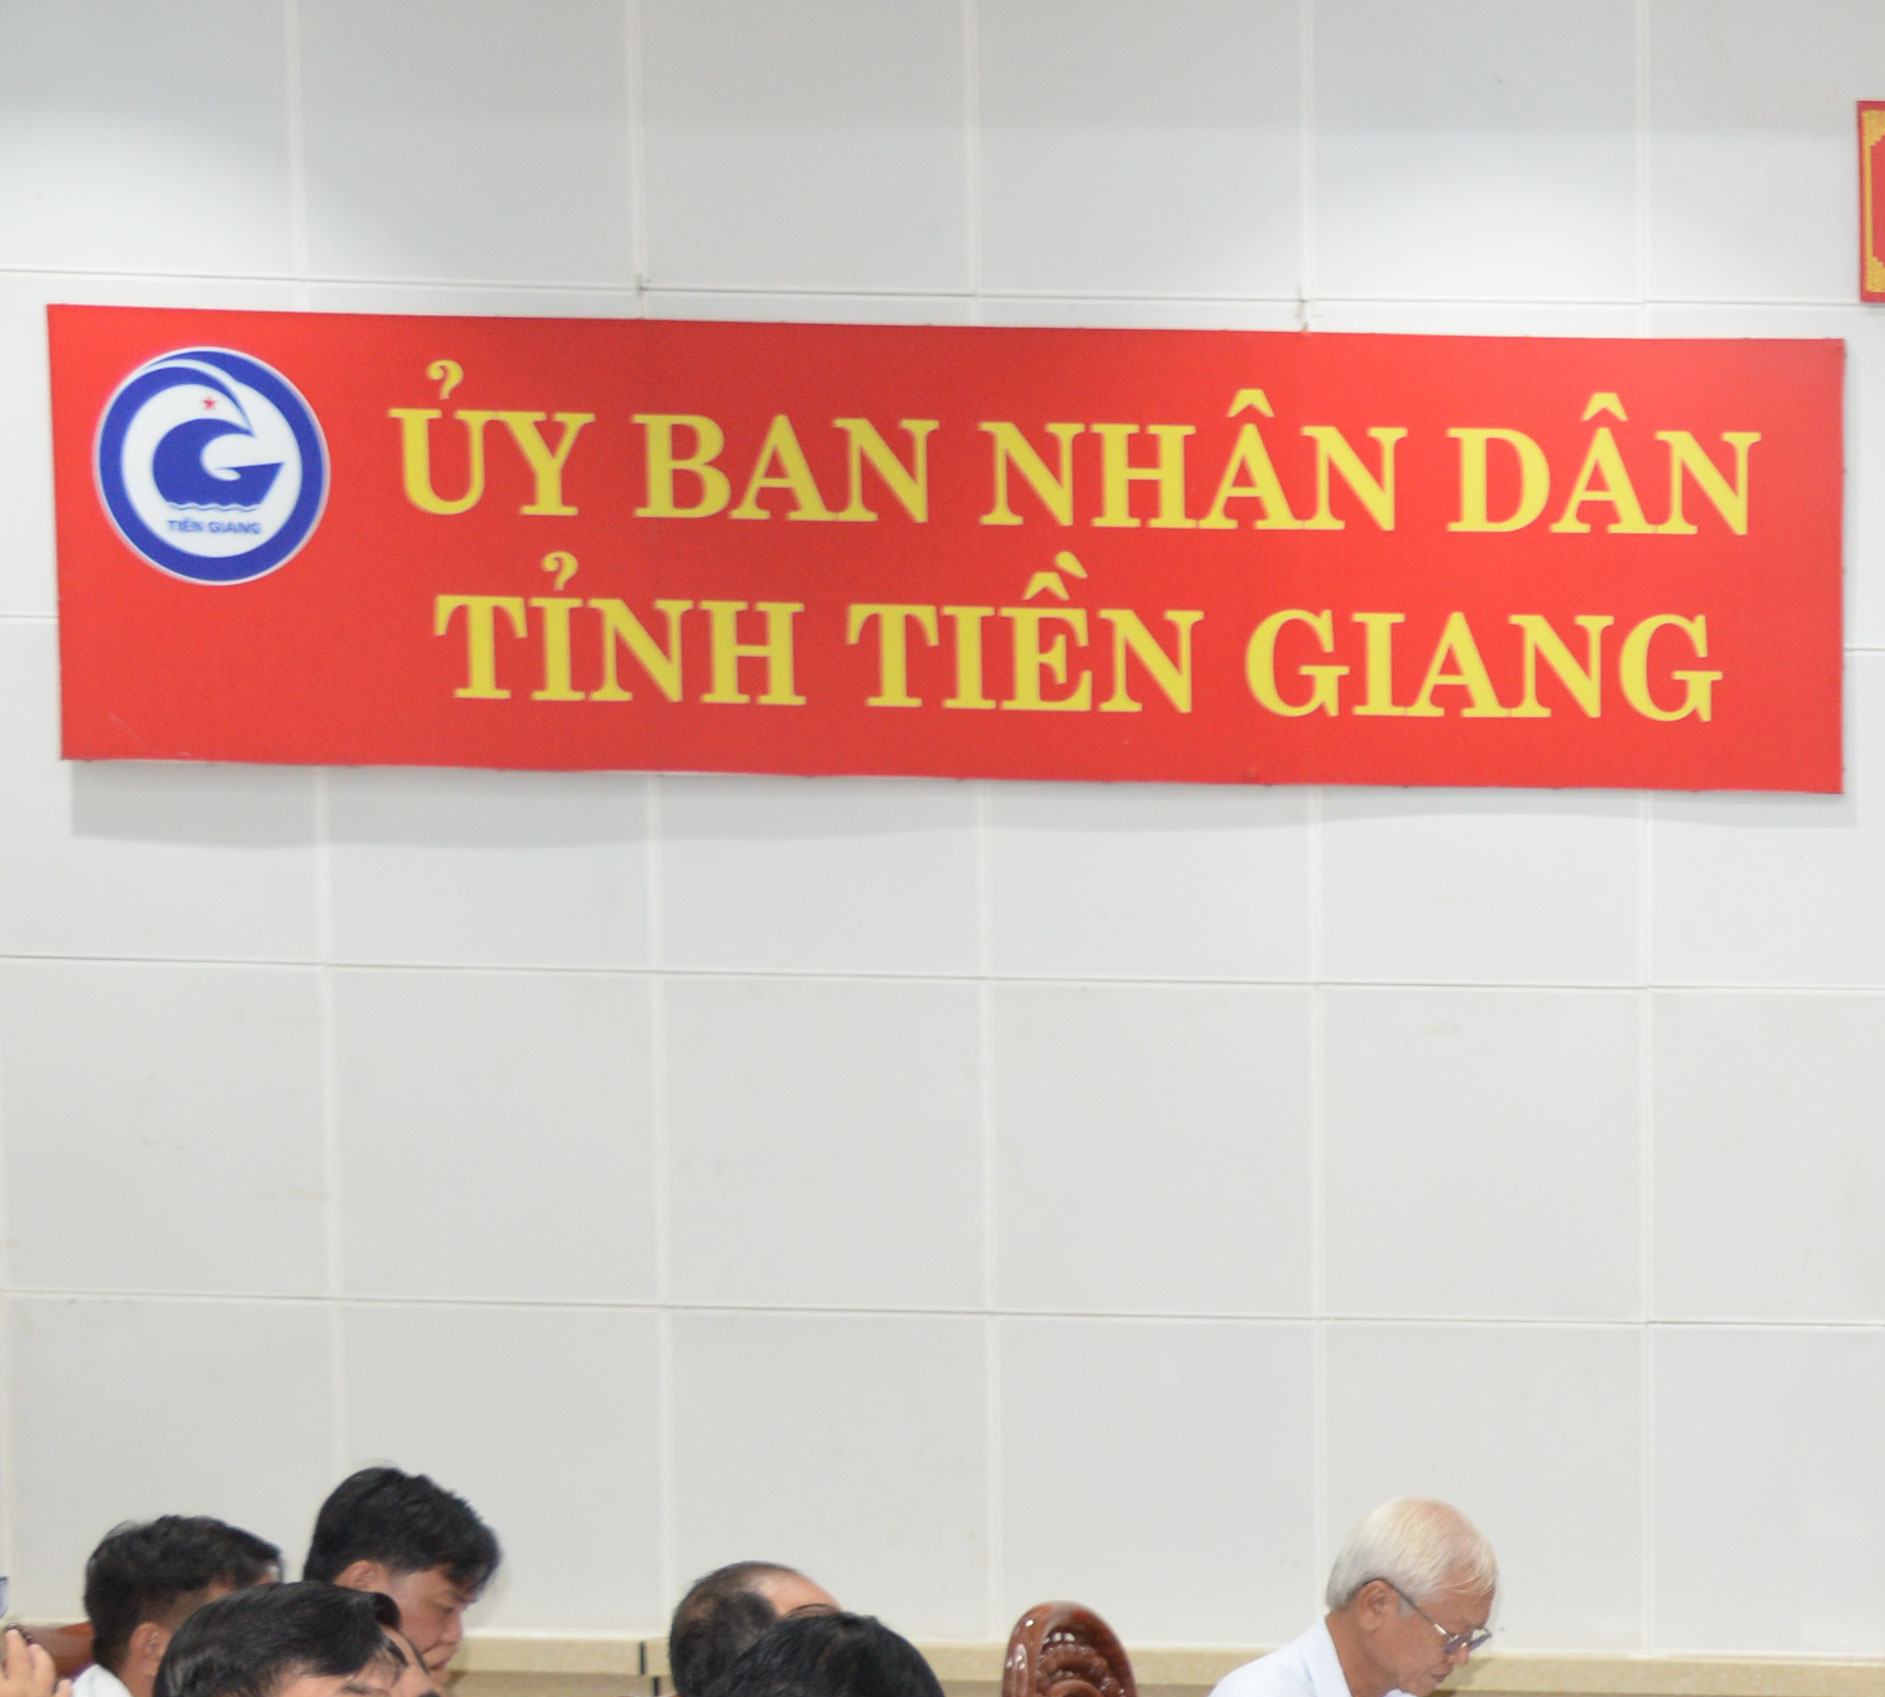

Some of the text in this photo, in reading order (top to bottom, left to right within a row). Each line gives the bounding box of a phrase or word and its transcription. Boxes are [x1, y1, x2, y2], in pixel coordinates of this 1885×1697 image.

[387, 358, 1762, 536] ỦY BAN NHÂN DÂN
[434, 550, 1724, 723] TỈNH TIỀN GIANG
